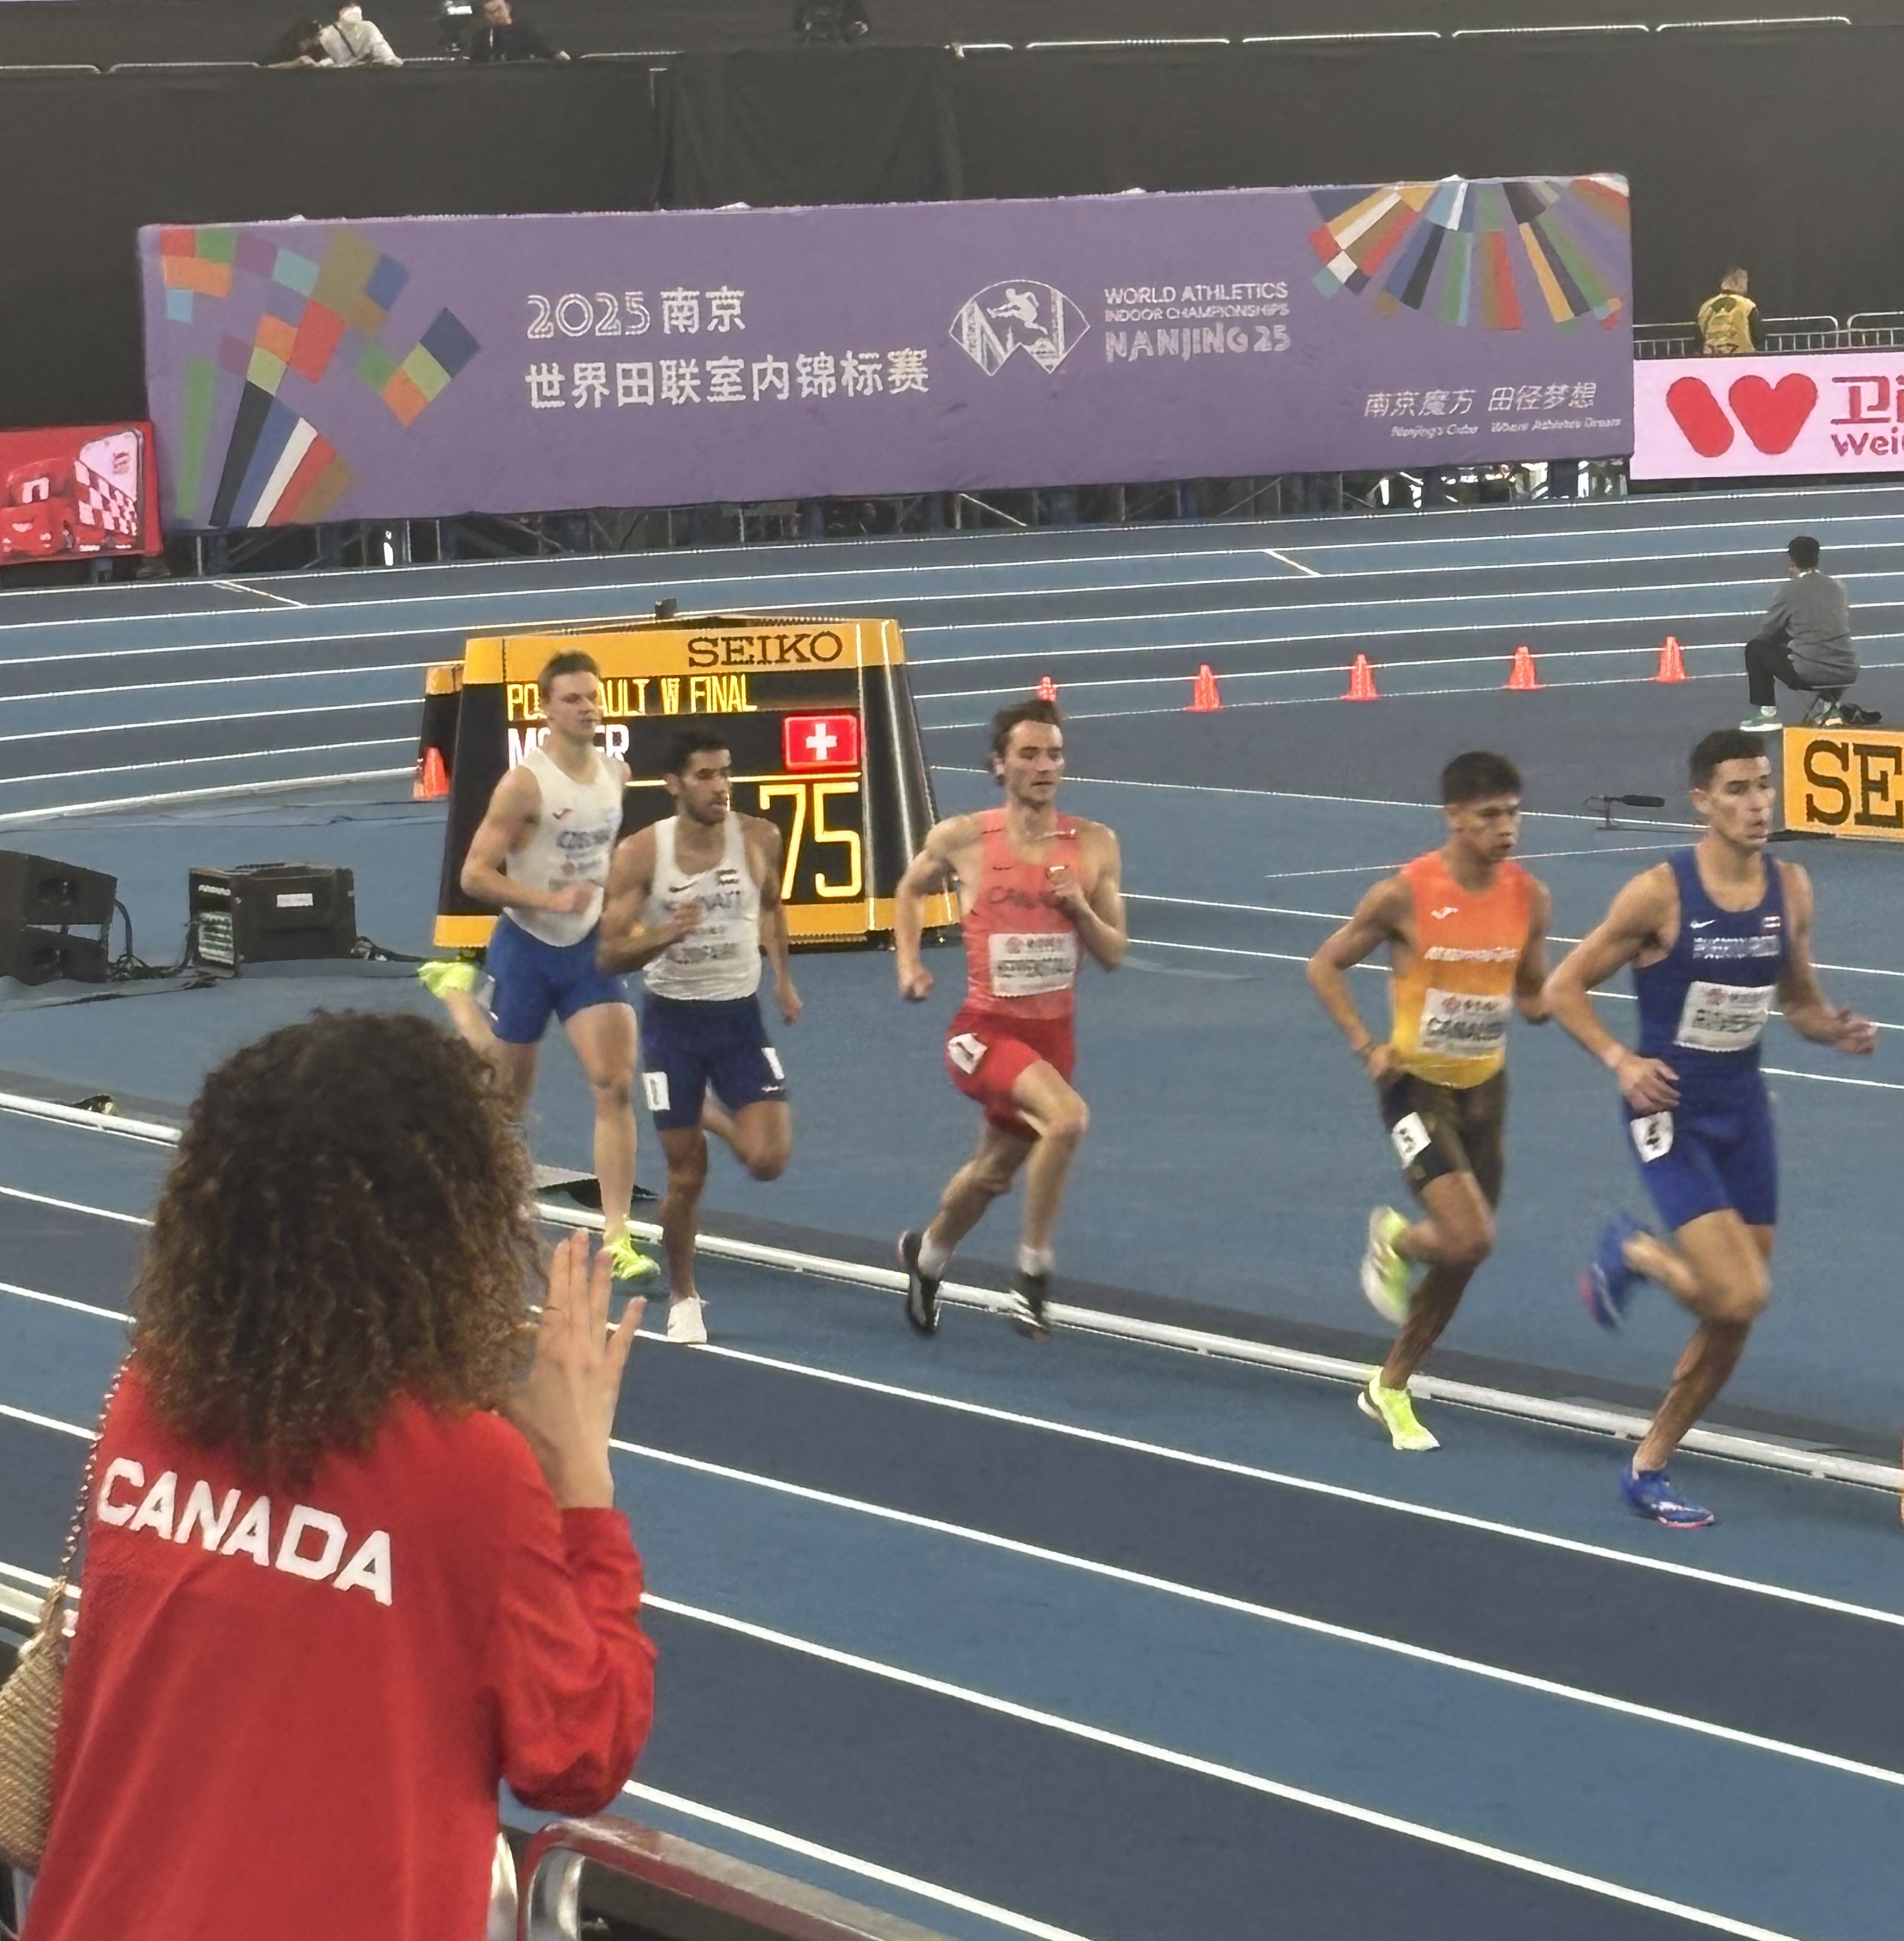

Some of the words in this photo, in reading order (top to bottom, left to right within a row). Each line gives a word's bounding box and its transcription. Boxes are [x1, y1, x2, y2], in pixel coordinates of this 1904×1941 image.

[1105, 284, 1176, 304] WORLD
[1181, 282, 1288, 302] ATHLETICS
[526, 290, 650, 339] 2025
[660, 286, 746, 334] 南京
[1106, 308, 1163, 322] INDOOR
[1167, 303, 1291, 320] CHAMPIONSHIPS
[1106, 322, 1249, 362] NANJING
[1254, 324, 1291, 352] 25
[525, 347, 930, 409] 世界田联室内锦标赛
[1364, 389, 1477, 417] 南京魔方
[1487, 382, 1597, 412] 田径梦想
[1830, 426, 1904, 457] Wei
[687, 630, 843, 667] SEIKO
[689, 674, 758, 713] FINAL
[96, 1457, 393, 1607] CANADA
